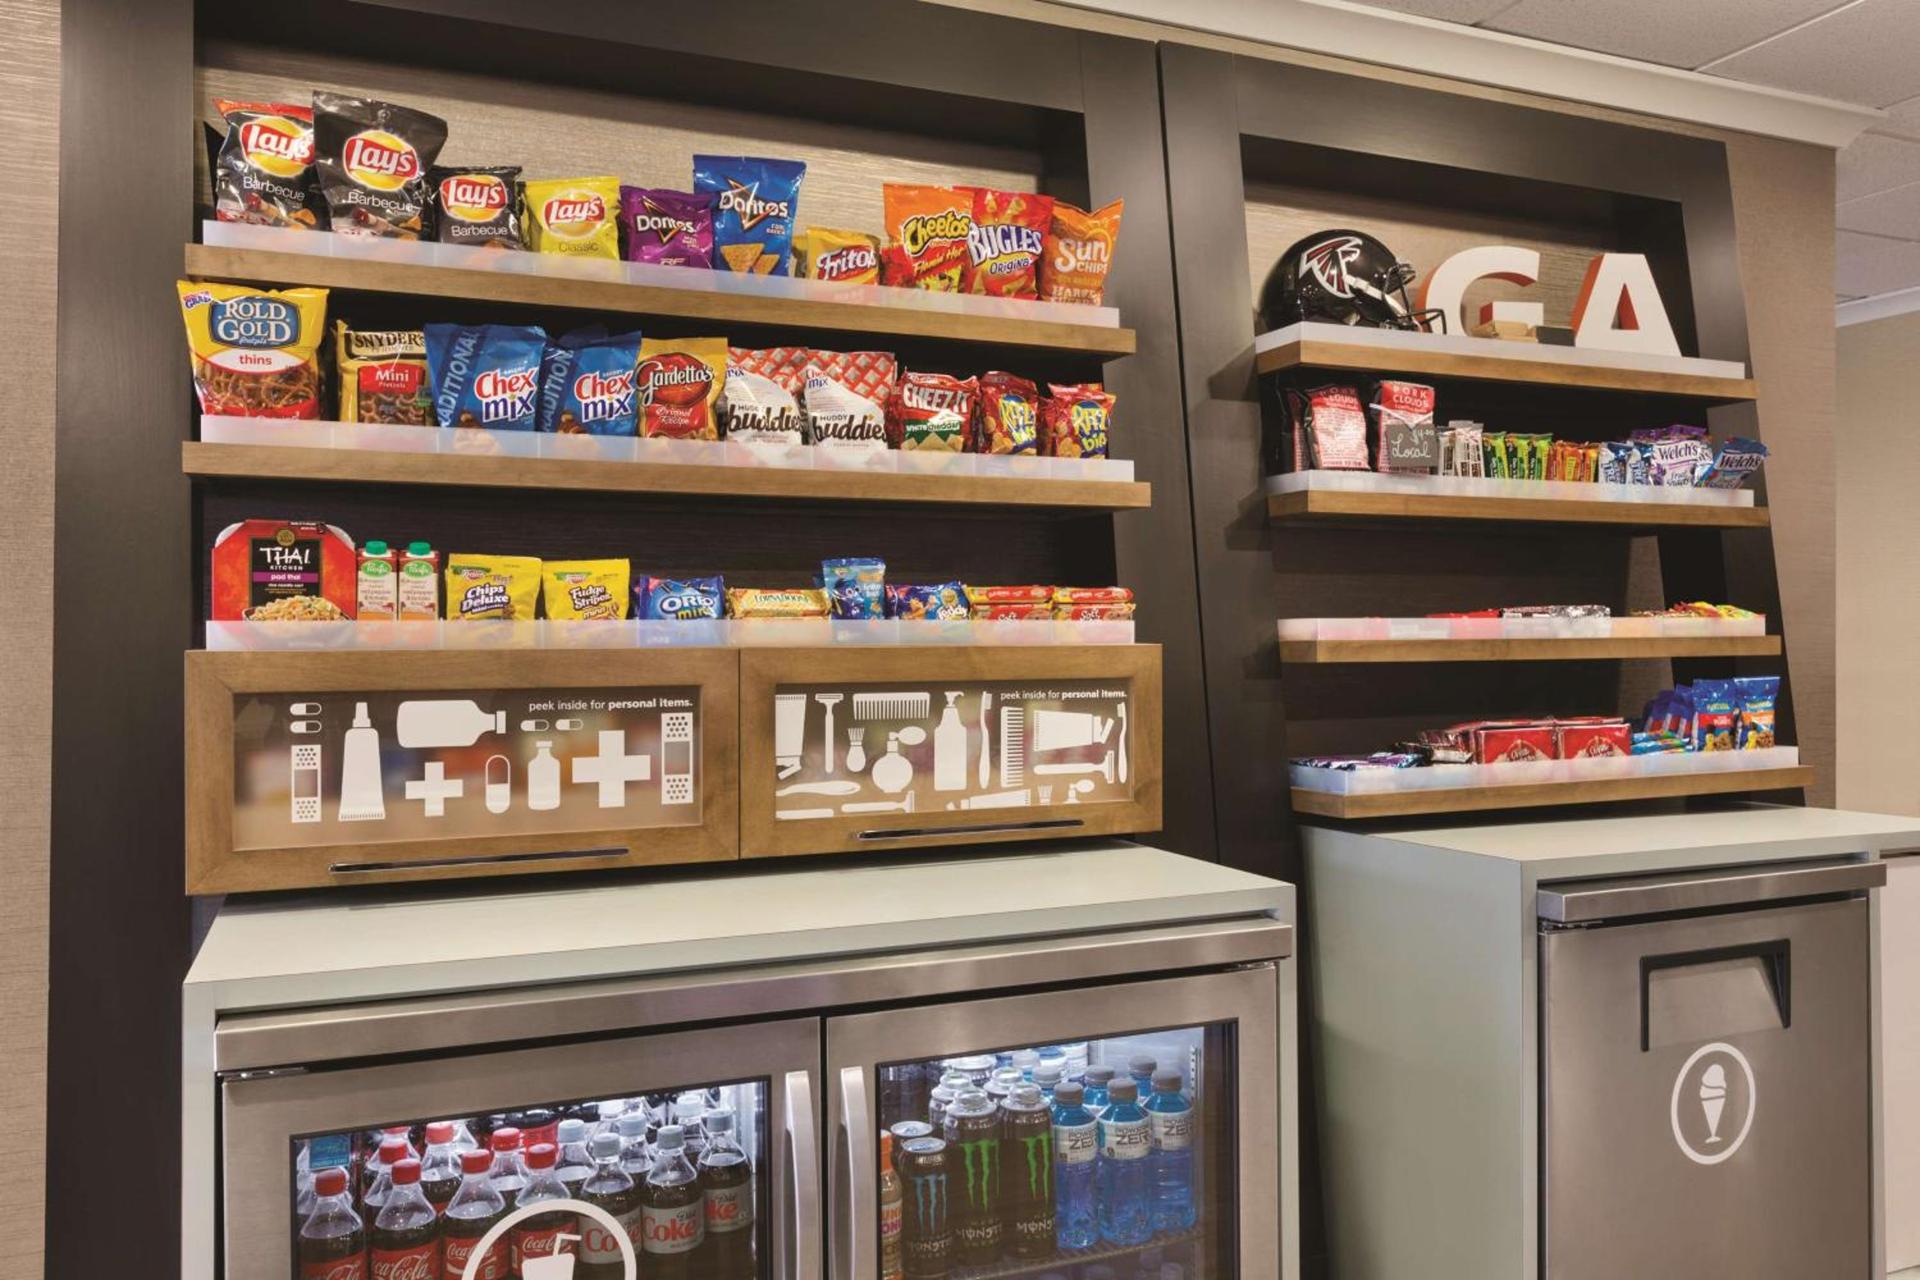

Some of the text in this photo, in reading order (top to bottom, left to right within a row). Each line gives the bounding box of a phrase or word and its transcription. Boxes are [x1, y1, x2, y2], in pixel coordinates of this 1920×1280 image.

[349, 138, 415, 178] Lay's
[243, 176, 305, 203] Barbecue
[448, 179, 503, 209] Lay's
[550, 197, 601, 223] Lay's
[719, 192, 790, 218] Doritos
[451, 226, 508, 236] Barbecue
[636, 215, 697, 234] Doritos
[903, 210, 971, 256] Cheetos
[558, 242, 599, 254] Classic
[967, 222, 1042, 266] BUGLES
[224, 302, 287, 320] ROLD
[1421, 245, 1684, 358] GA
[217, 319, 292, 342] GOLD
[240, 355, 272, 366] thins
[376, 369, 409, 382] Mini
[474, 368, 539, 400] Chex
[574, 370, 634, 402] Chex
[636, 360, 714, 407] Gardetto's
[1392, 386, 1427, 399] PORK
[483, 391, 535, 422] mix
[582, 390, 635, 423] mix
[1391, 433, 1432, 458] Local
[1659, 443, 1699, 460] Welch's
[1718, 453, 1761, 468] Welch's
[259, 547, 310, 566] THAI
[466, 583, 504, 600] Chips
[571, 585, 604, 600] Fudge
[462, 596, 510, 613] Deluxe
[529, 698, 693, 711] peek inside for personal items.
[1000, 689, 1127, 701] peek inside for personal items.
[644, 1216, 697, 1242] Coke
